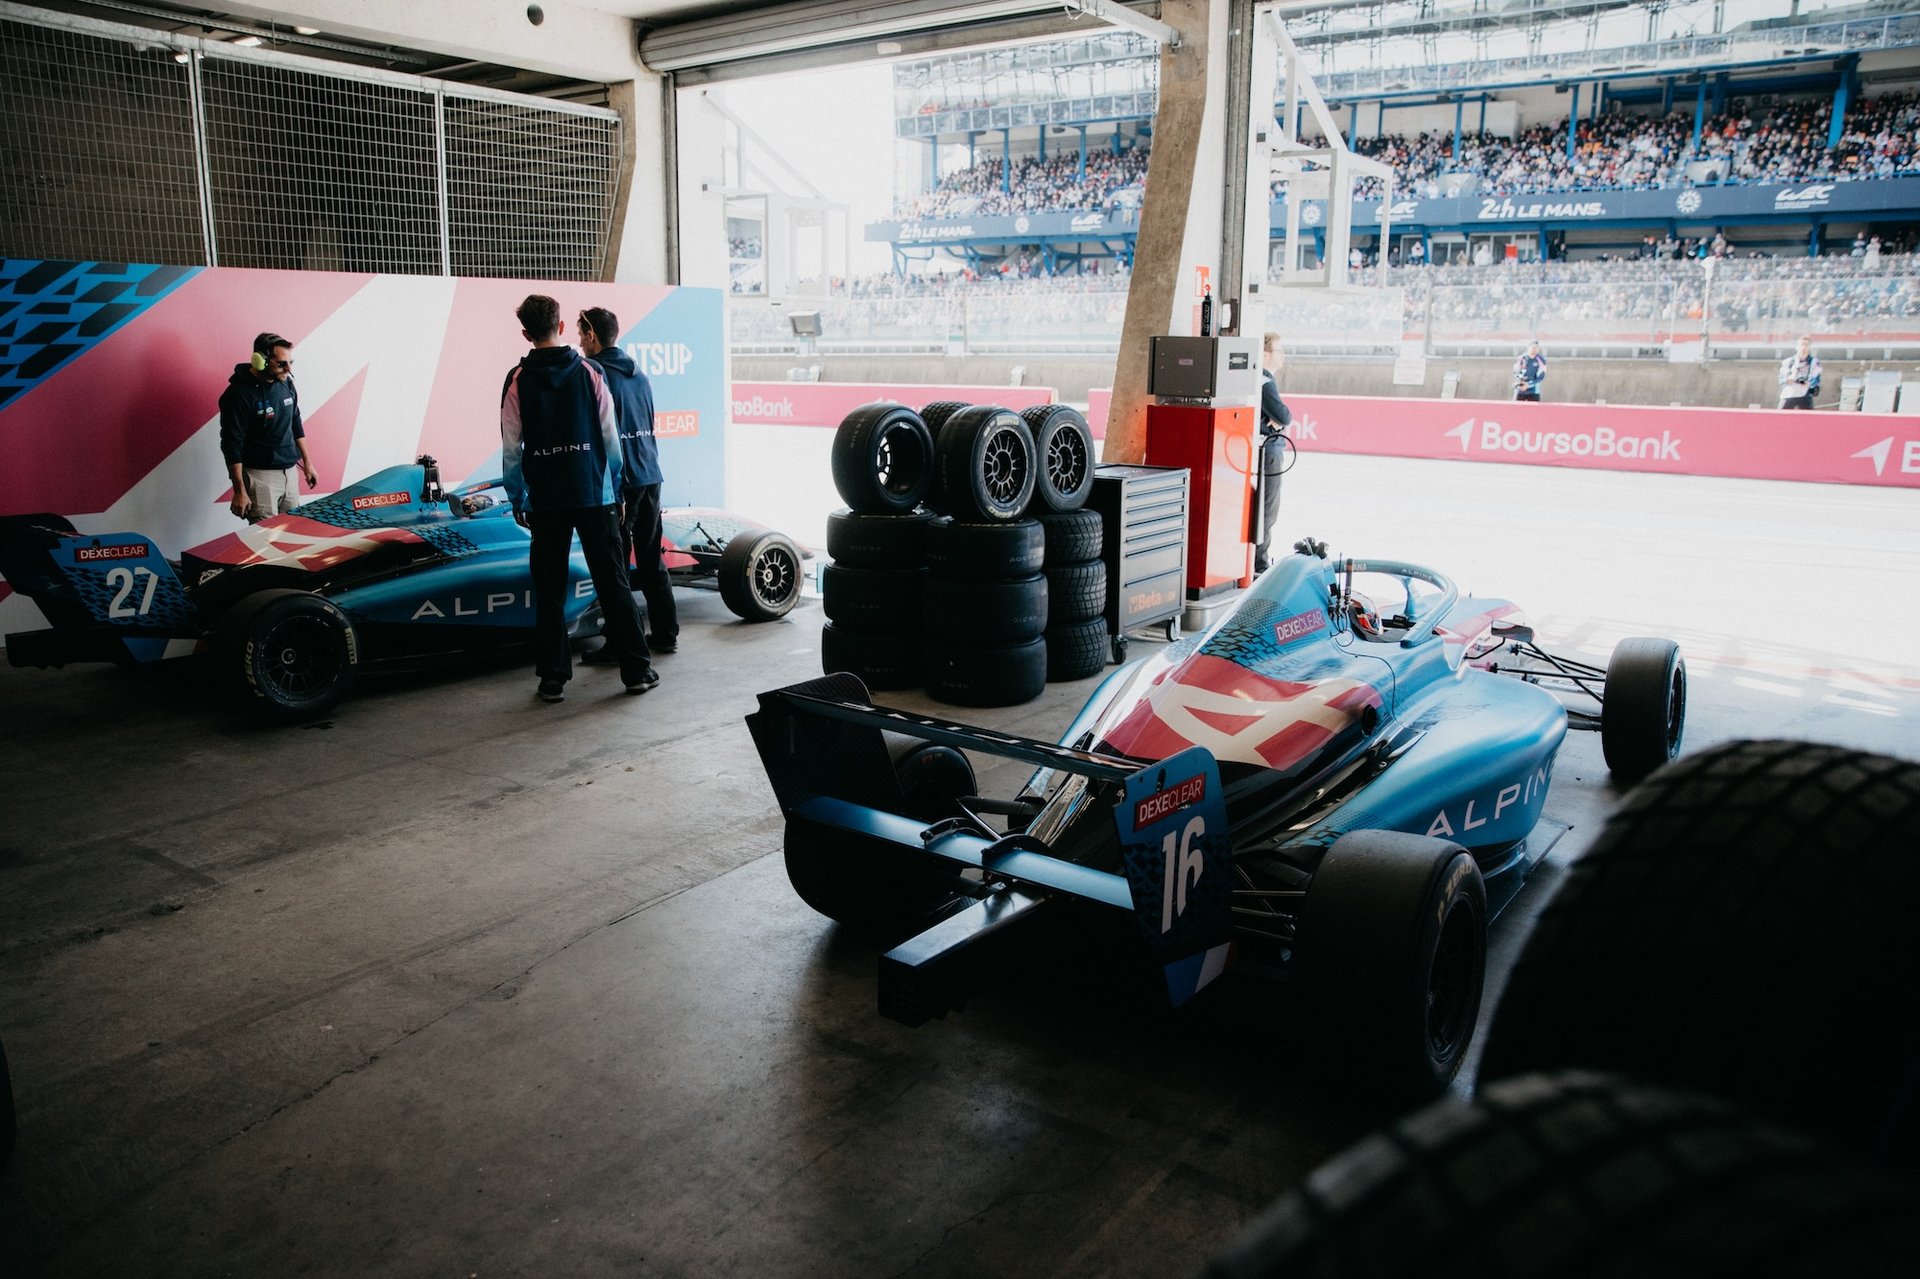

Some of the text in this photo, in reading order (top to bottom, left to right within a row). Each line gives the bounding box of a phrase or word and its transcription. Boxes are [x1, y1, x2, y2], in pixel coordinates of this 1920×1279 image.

[1517, 205, 1543, 218] LE
[533, 443, 591, 456] ALPINE
[1480, 421, 1682, 461] BoursoBank
[354, 493, 409, 508] DEXECLEAR
[80, 545, 145, 559] DEXECLEAR
[106, 566, 159, 619] 27
[411, 579, 594, 620] ALPIE
[1276, 610, 1325, 641] DEXECLEAR
[245, 640, 257, 685] ZERO
[1139, 779, 1203, 823] DEXECLEAR
[1425, 757, 1554, 838] ALPIN
[1161, 815, 1206, 935] 16
[1445, 862, 1473, 901] ZERO
